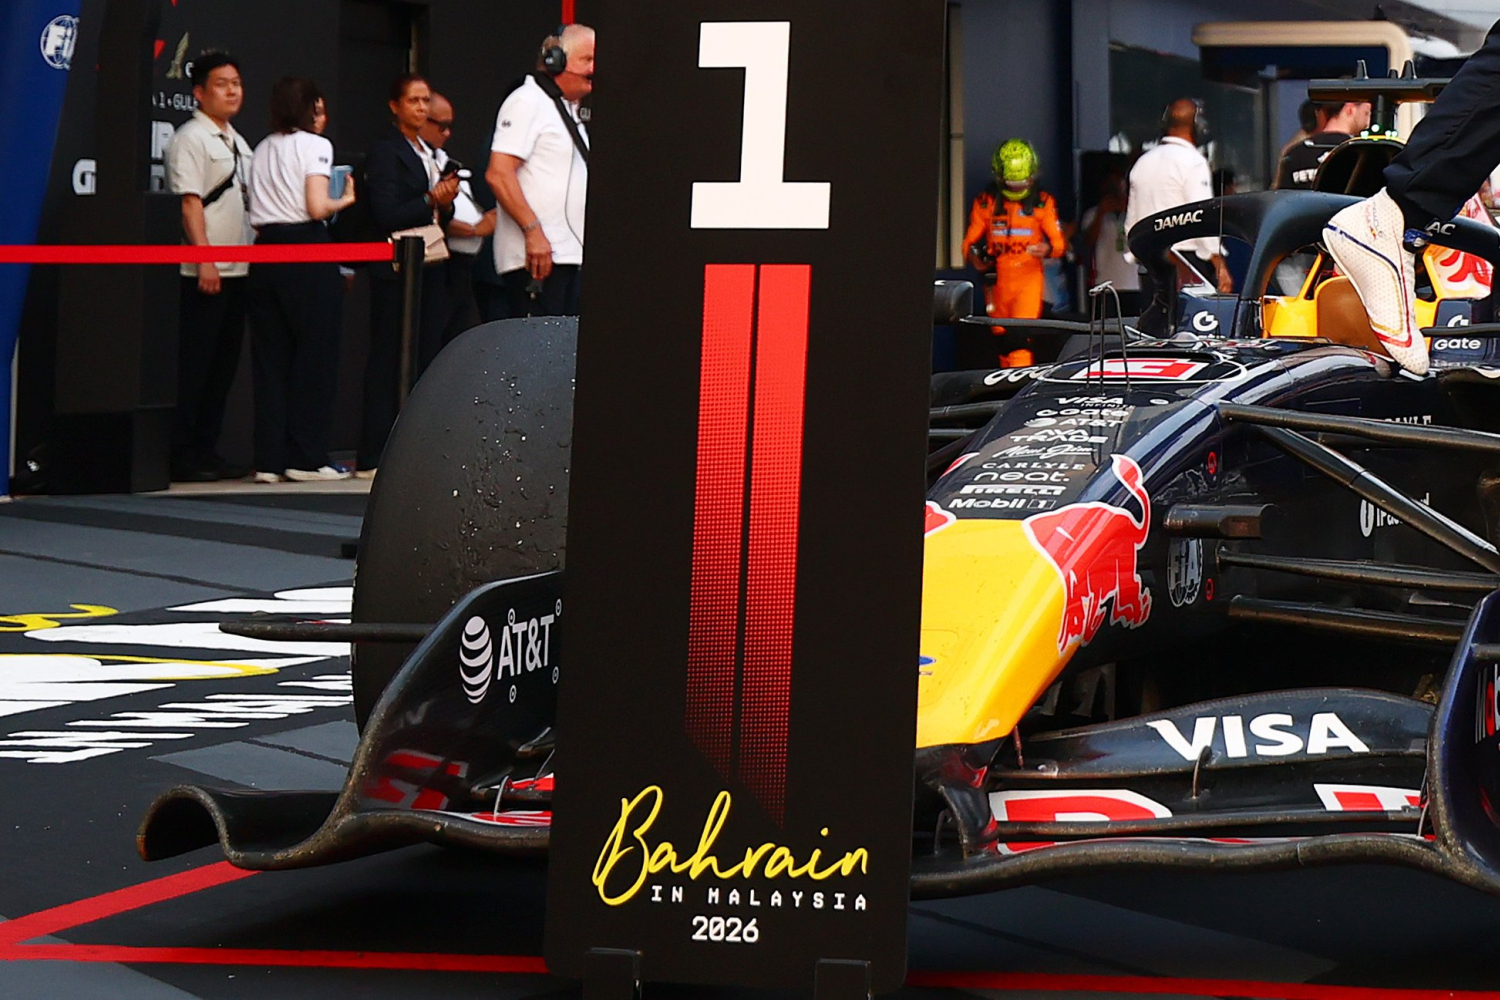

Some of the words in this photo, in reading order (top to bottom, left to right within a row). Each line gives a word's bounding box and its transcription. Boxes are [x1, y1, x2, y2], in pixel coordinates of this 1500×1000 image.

[690, 21, 832, 229] 1
[1434, 336, 1482, 351] Gate
[1056, 396, 1124, 405] VISA
[1058, 418, 1124, 428] AT&T
[1009, 435, 1109, 444] TRADE
[982, 462, 1086, 471] CARLYLE
[973, 471, 1071, 483] neat.
[959, 484, 1067, 496] PIRELLI
[948, 498, 1028, 510] Mobil
[497, 615, 555, 681] AT&T
[1145, 712, 1371, 761] VISA
[592, 785, 868, 906] Bahrain
[650, 885, 684, 903] IN
[707, 888, 867, 912] MALAYSIA
[690, 915, 760, 943] 2026
